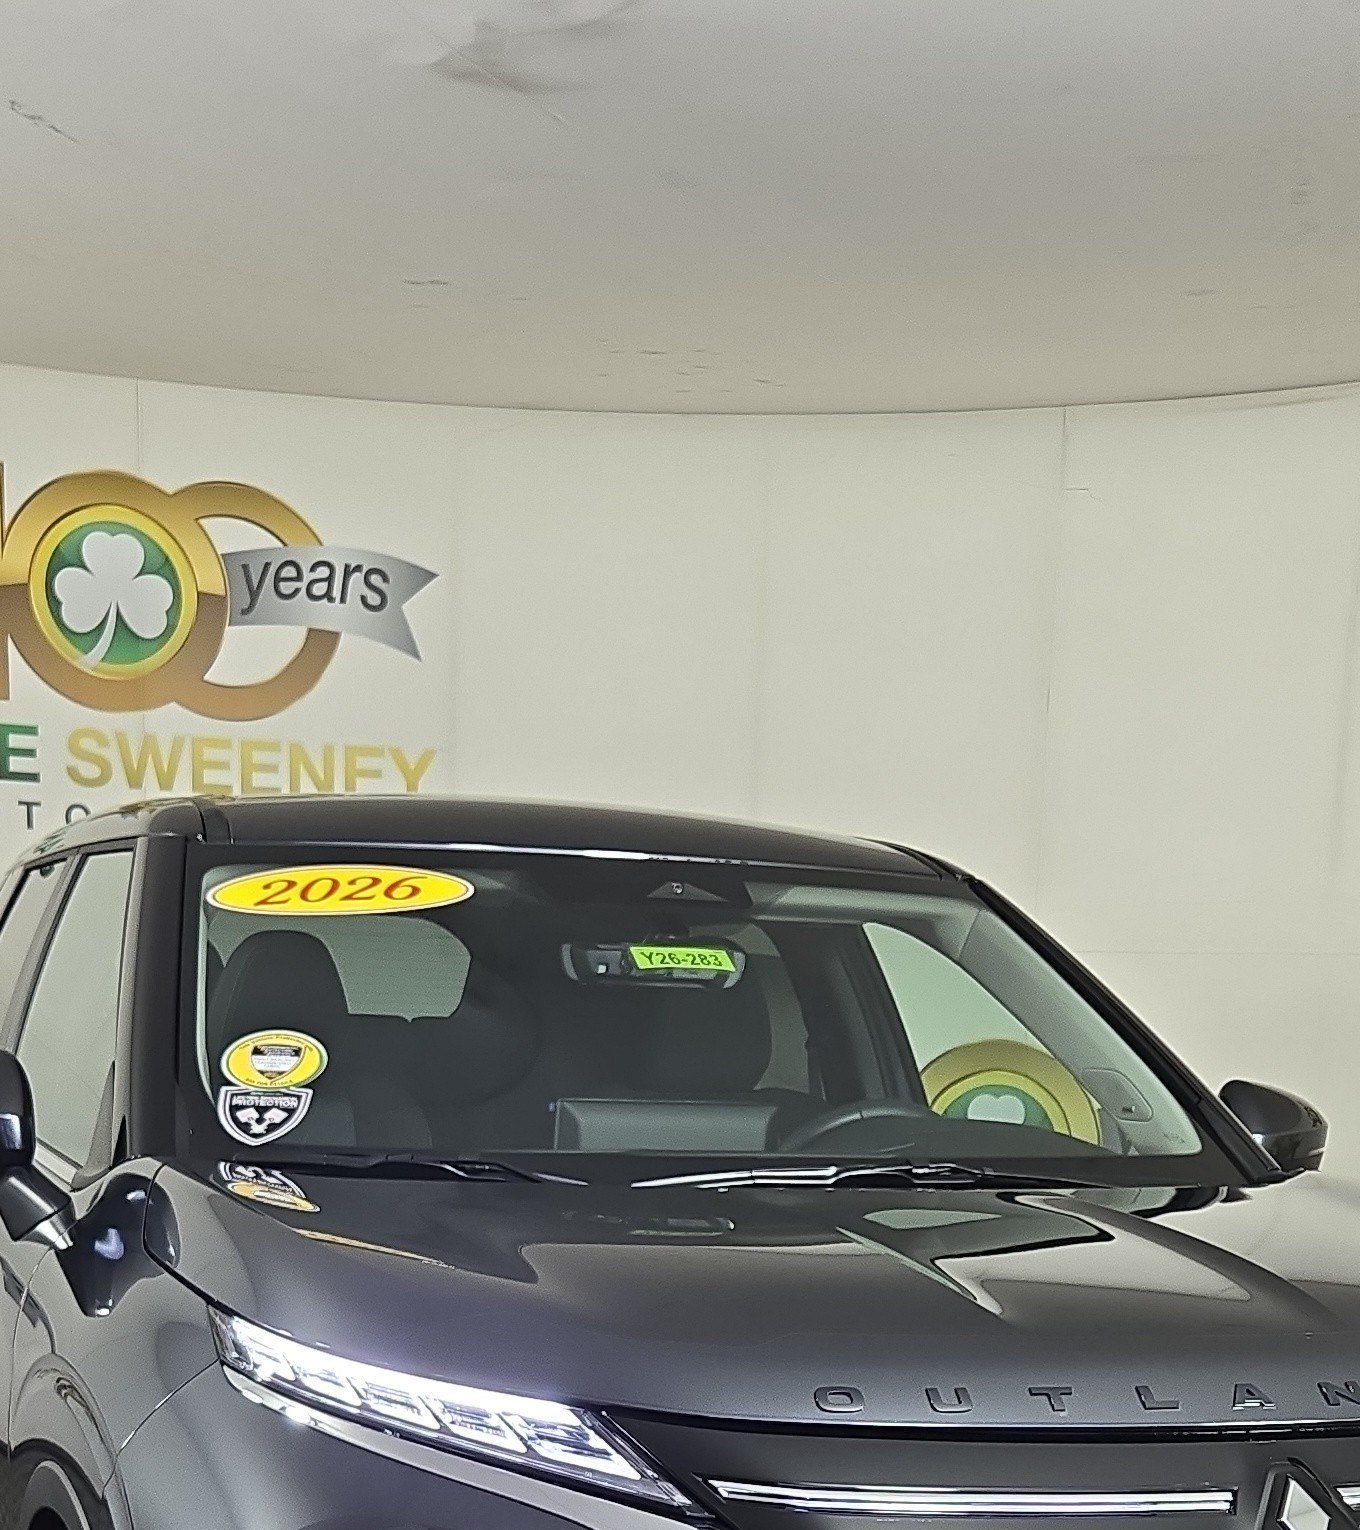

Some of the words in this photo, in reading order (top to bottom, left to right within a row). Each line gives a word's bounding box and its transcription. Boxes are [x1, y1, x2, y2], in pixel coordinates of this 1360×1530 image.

[240, 557, 390, 615] years
[254, 876, 428, 906] 2026
[640, 952, 723, 967] Y26-283
